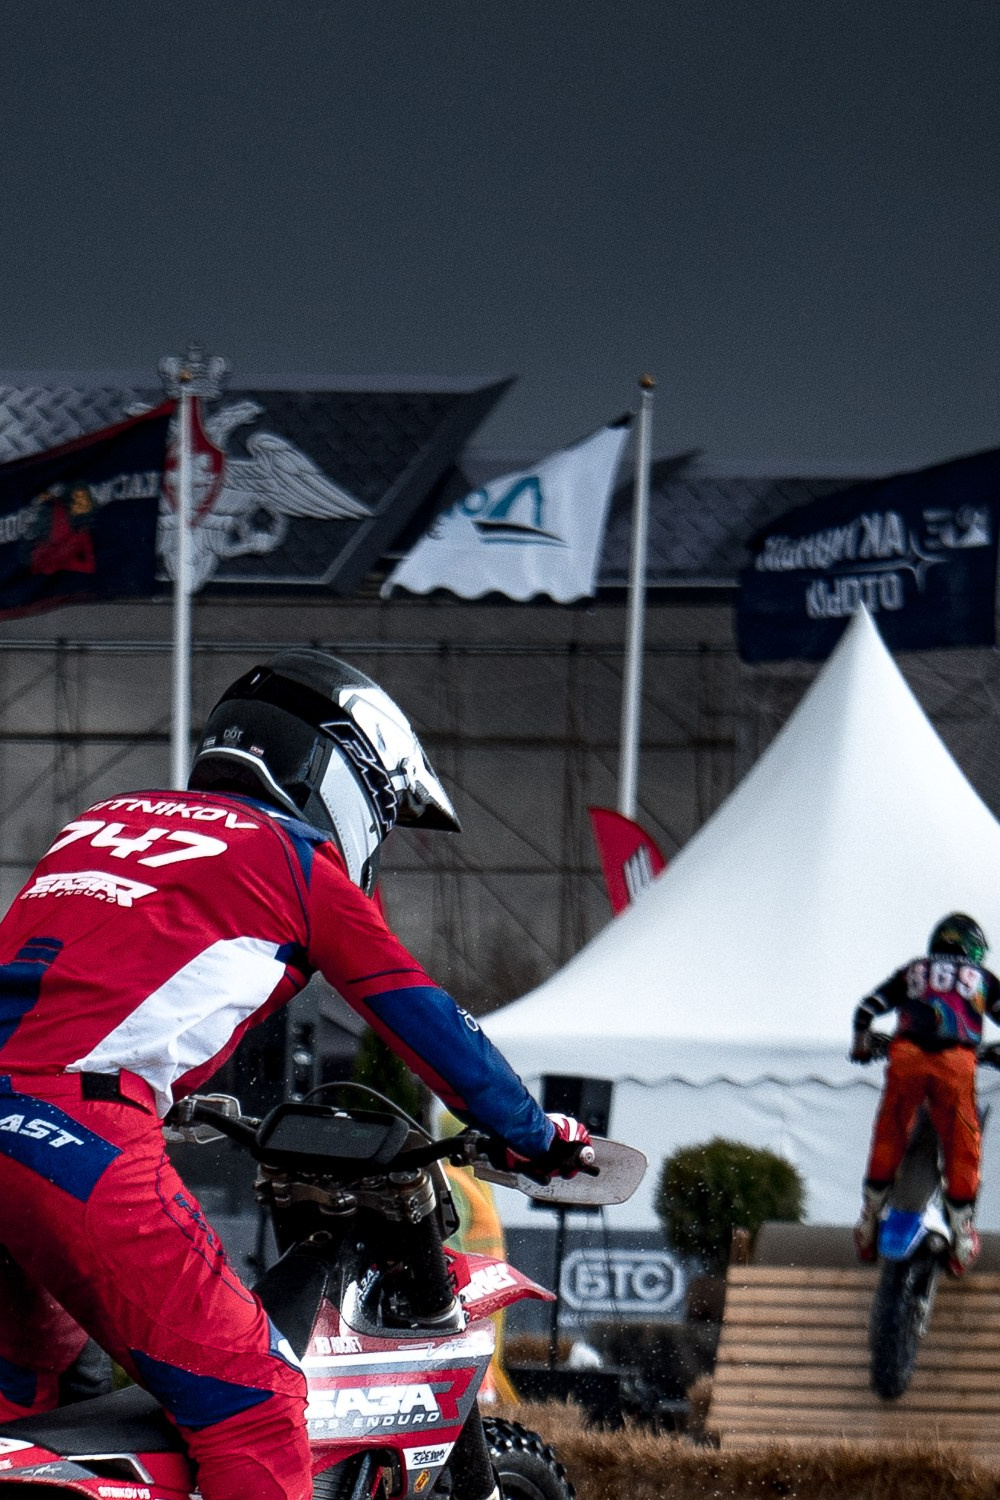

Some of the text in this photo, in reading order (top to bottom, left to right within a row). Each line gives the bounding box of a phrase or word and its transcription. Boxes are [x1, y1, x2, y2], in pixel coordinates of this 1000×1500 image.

[86, 798, 260, 829] ITNIKOV
[45, 820, 228, 867] 747
[55, 889, 117, 903] ENDURO
[353, 1412, 440, 1428] ENDURO
